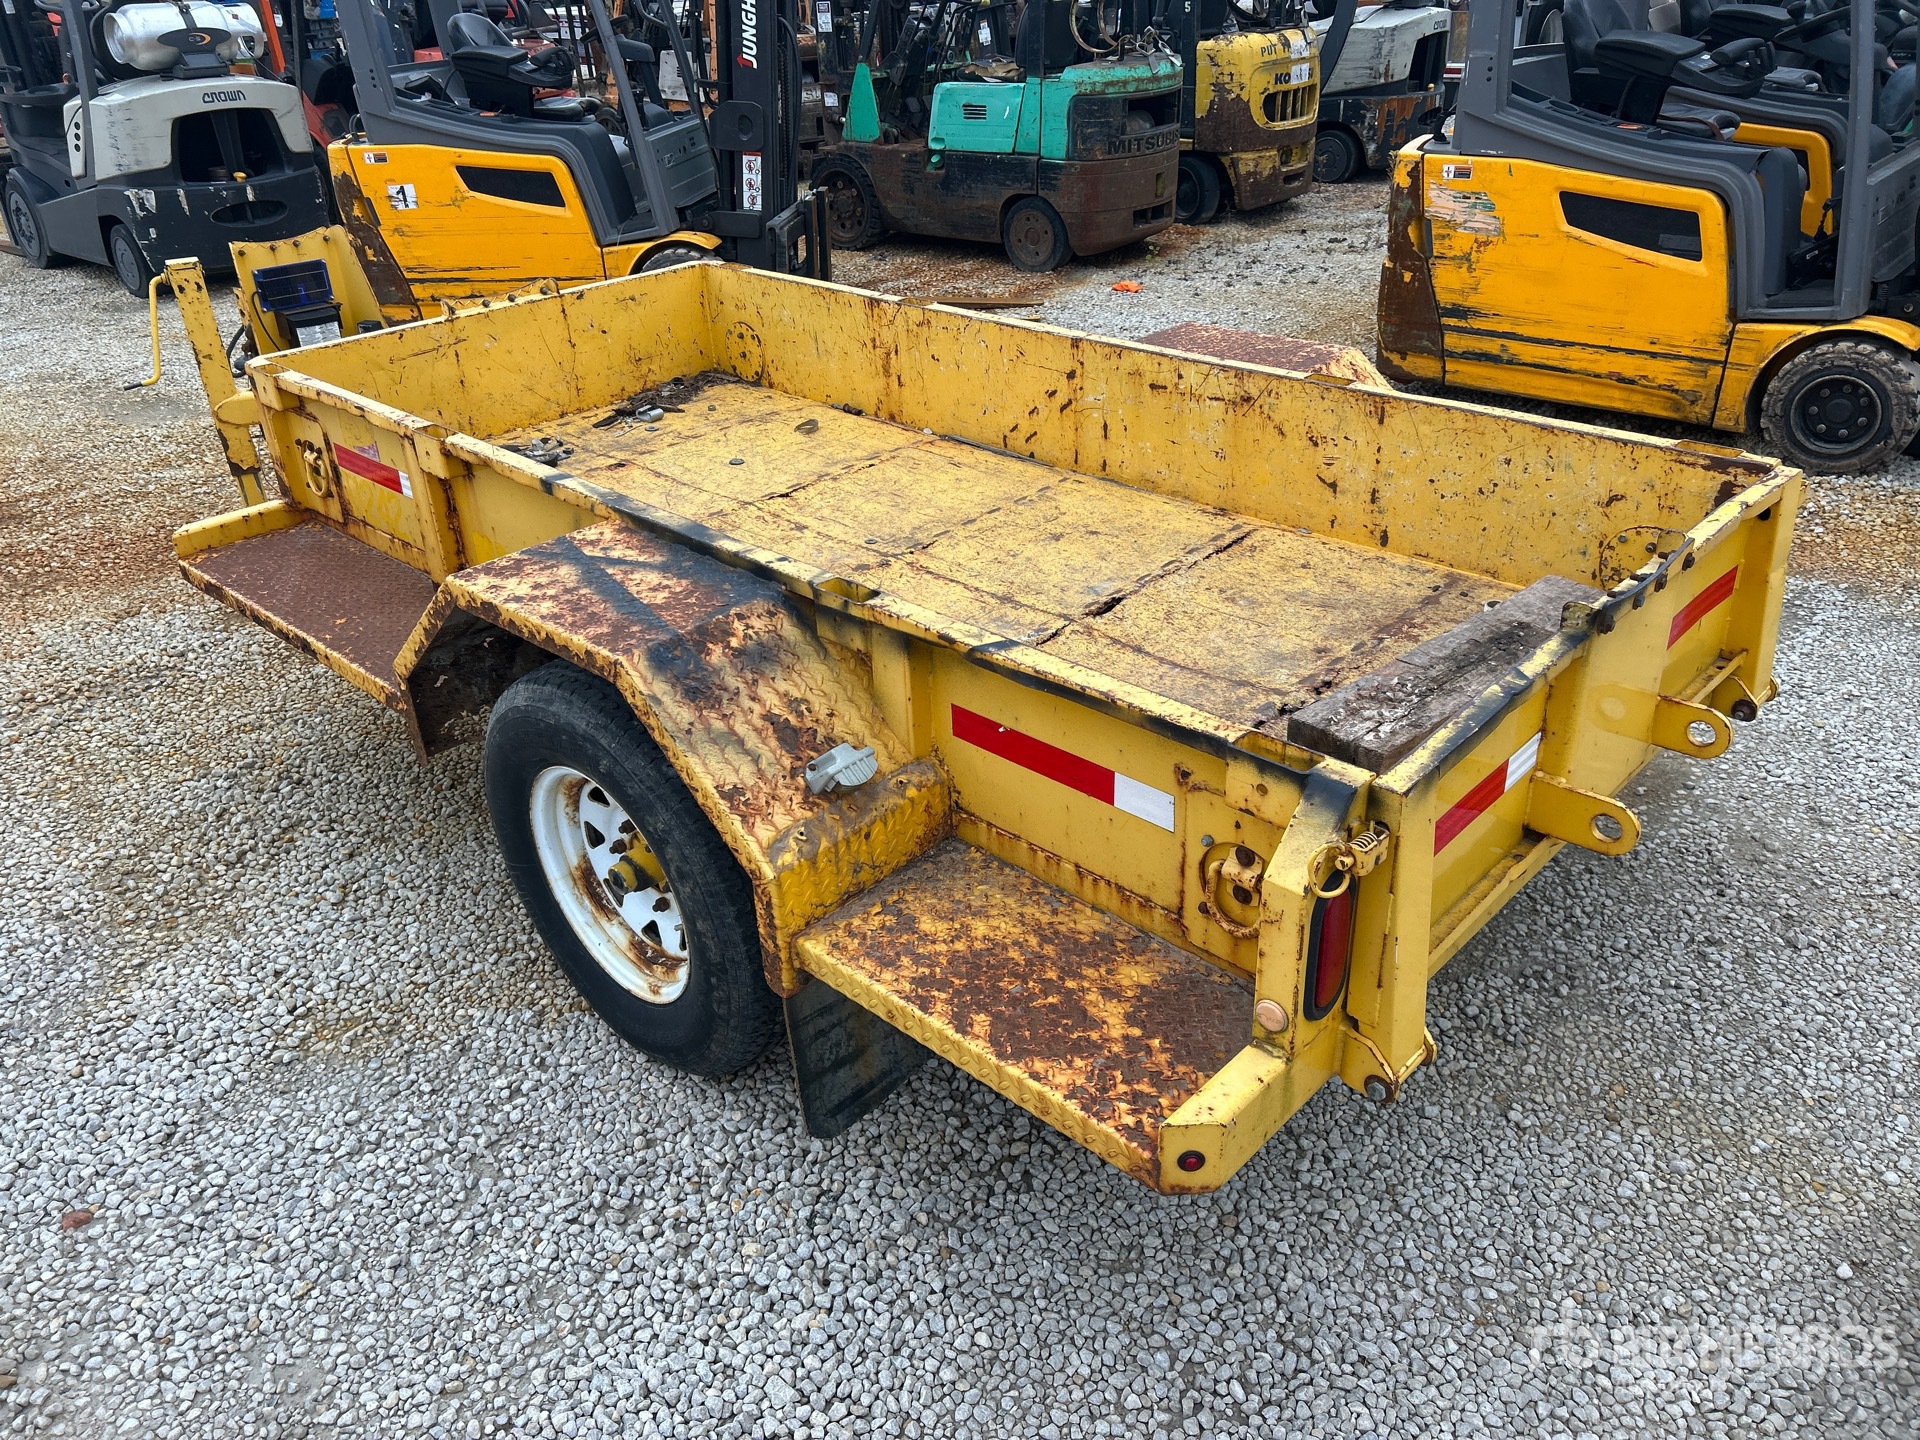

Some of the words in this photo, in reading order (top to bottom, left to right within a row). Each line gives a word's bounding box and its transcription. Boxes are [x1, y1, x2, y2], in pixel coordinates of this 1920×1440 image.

[1260, 43, 1277, 57] PUT
[202, 90, 246, 104] CROWN
[396, 185, 409, 208] 1
